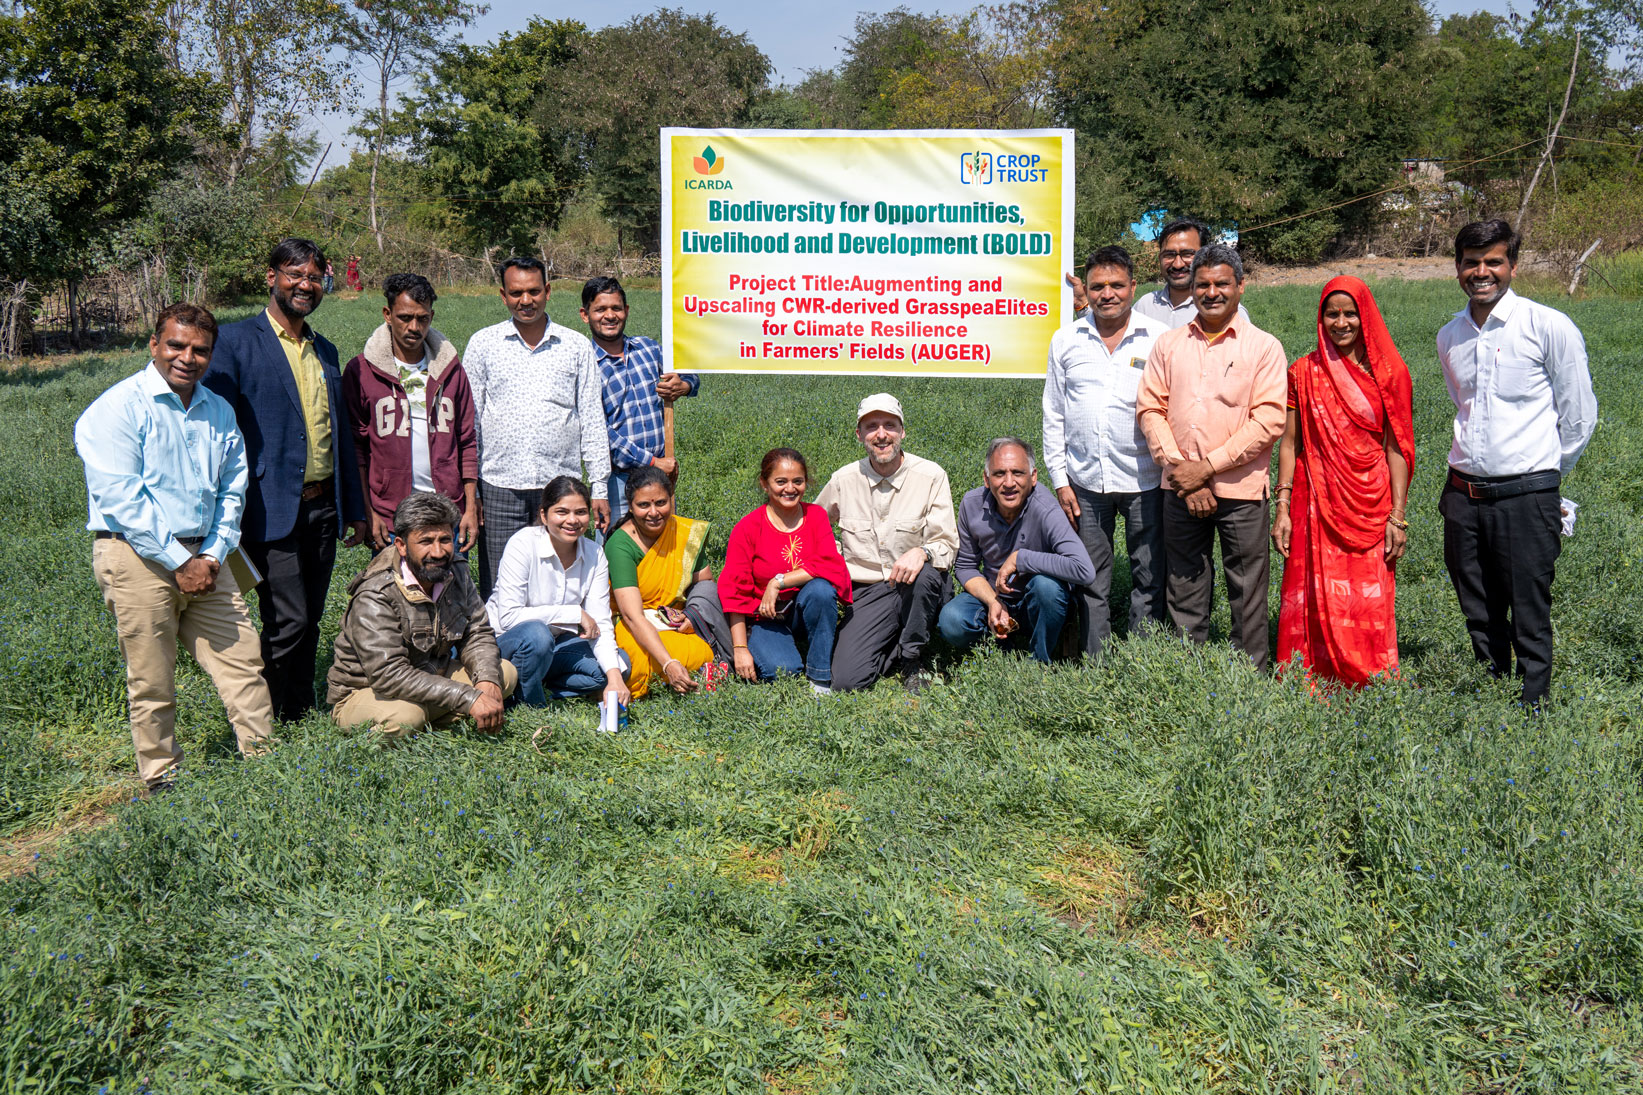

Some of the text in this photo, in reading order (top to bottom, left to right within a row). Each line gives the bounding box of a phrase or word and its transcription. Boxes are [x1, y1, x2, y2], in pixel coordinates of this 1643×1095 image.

[997, 155, 1040, 168] CROP
[685, 180, 733, 190] ICARDA
[997, 169, 1048, 183] TRUST
[709, 200, 1024, 225] Biodiversity for Opportunities,
[683, 232, 1051, 256] Livelihood and Development (BOLD)
[730, 275, 1001, 296] Project Title:Augmenting and
[685, 297, 1048, 318] Upscaling CWR-derived GrasspeaElites
[762, 320, 967, 337] for Climate Resilience
[740, 342, 990, 364] in Farmers' Fields (AUGER)
